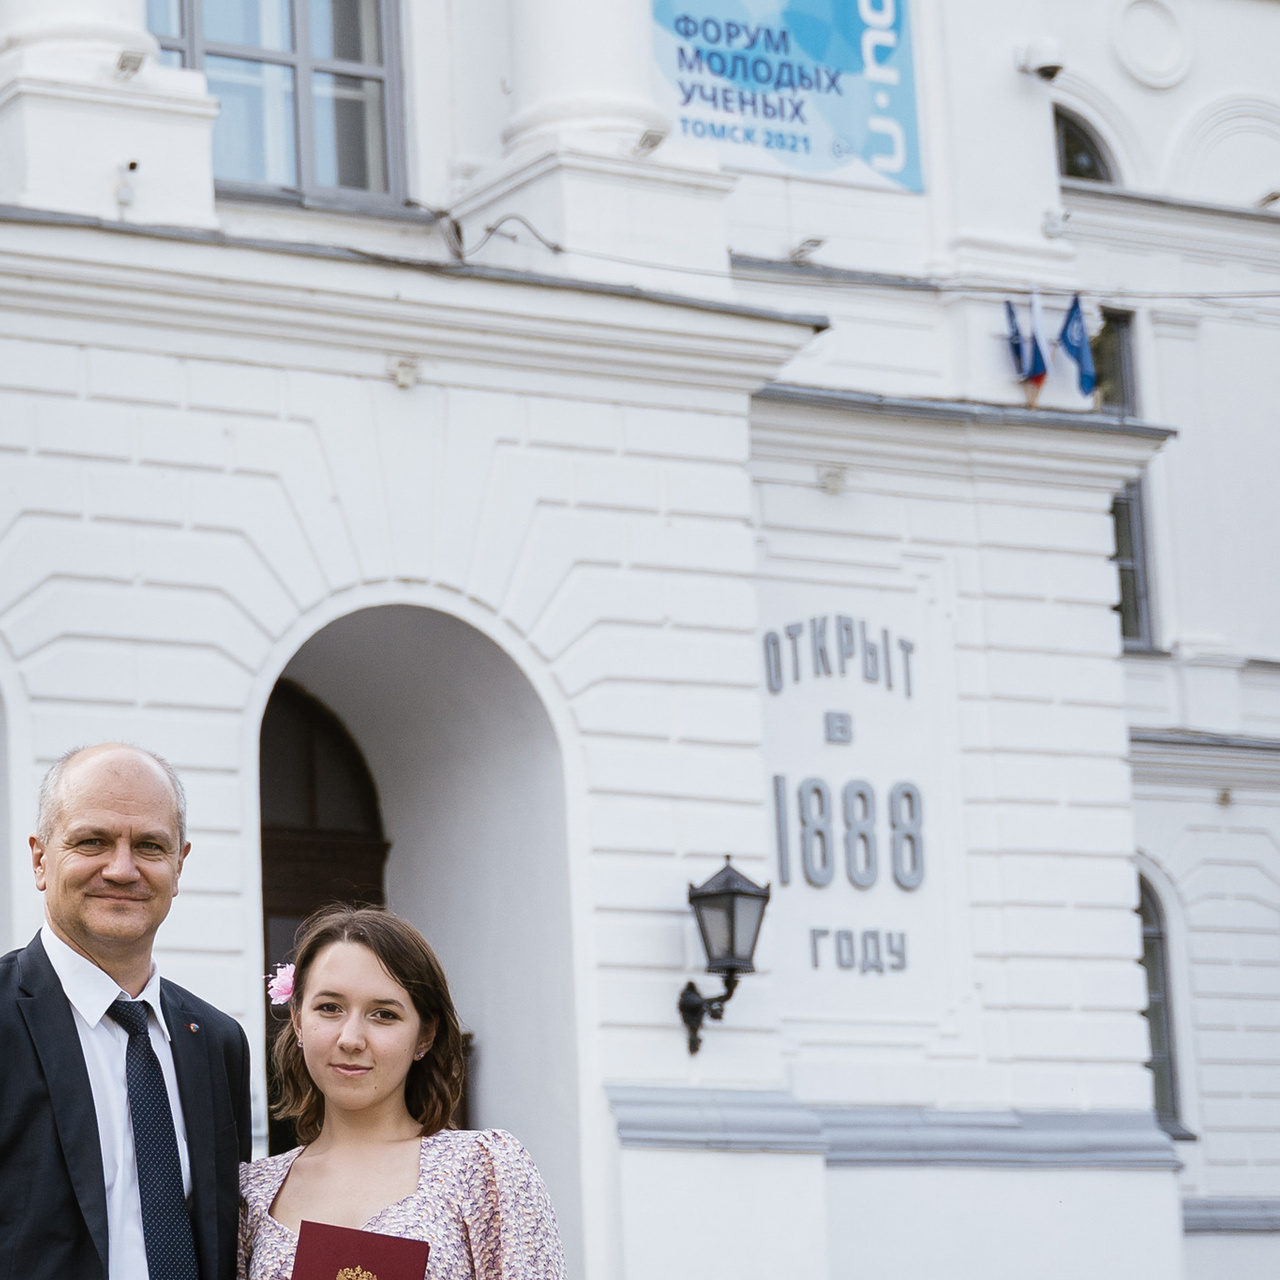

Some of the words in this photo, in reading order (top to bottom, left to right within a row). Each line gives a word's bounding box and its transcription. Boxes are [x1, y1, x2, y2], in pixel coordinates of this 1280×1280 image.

[674, 15, 790, 56] ФОРУМ
[677, 46, 843, 96] МОЛОДЫХ
[677, 80, 807, 124] УЧЕНЫХ
[680, 118, 756, 144] ТОМСК
[763, 131, 811, 154] 2021
[764, 615, 915, 699] ОТКРЫТ
[824, 711, 853, 745] В
[773, 774, 925, 892] 1888
[809, 928, 907, 974] ГОДУ
